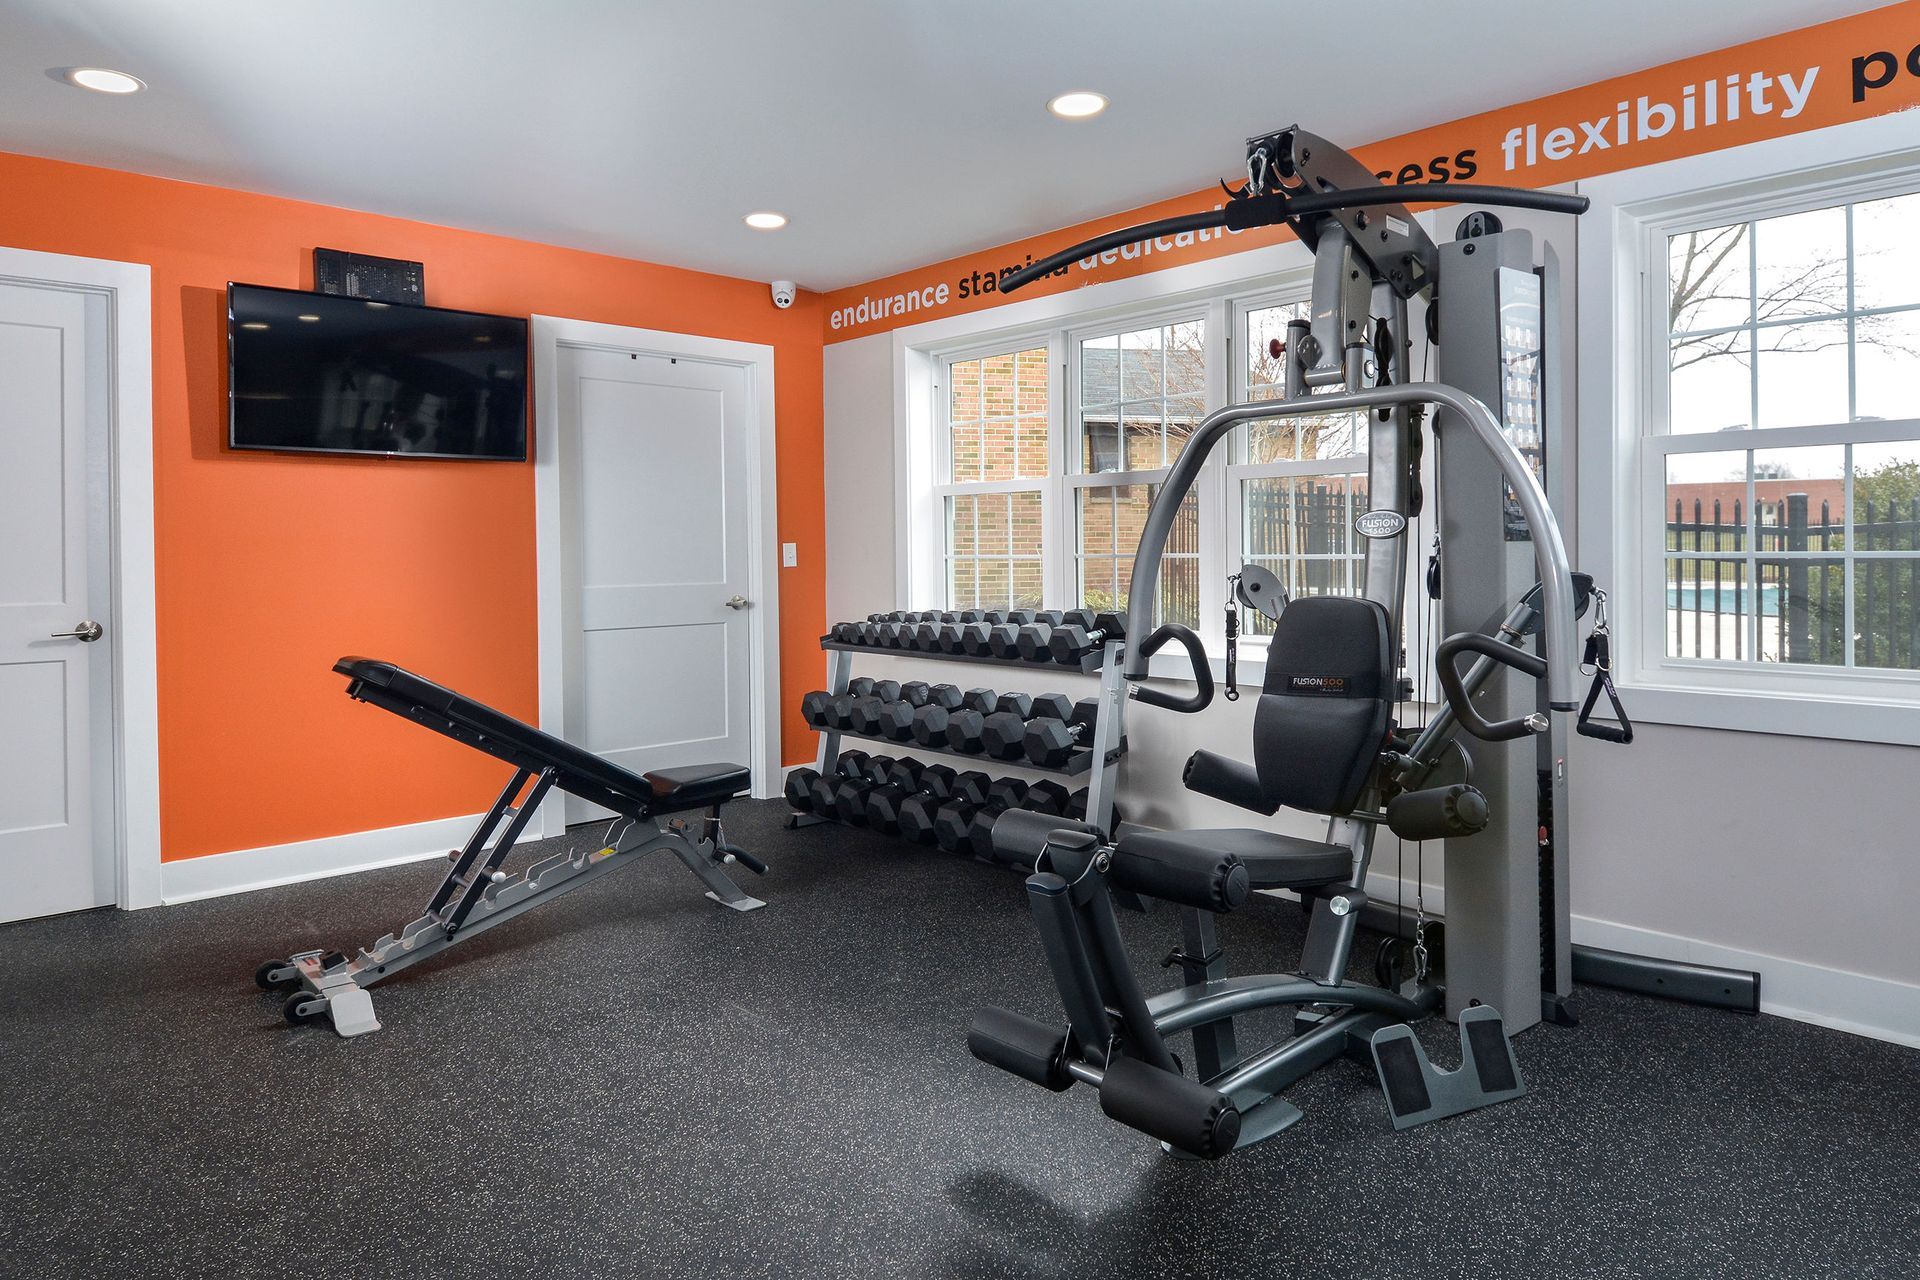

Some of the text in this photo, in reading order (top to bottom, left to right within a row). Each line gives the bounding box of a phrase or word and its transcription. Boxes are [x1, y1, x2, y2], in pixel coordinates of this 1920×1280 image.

[830, 283, 950, 329] endurance
[1501, 65, 1821, 171] flexibility
[1362, 518, 1399, 528] FUSION
